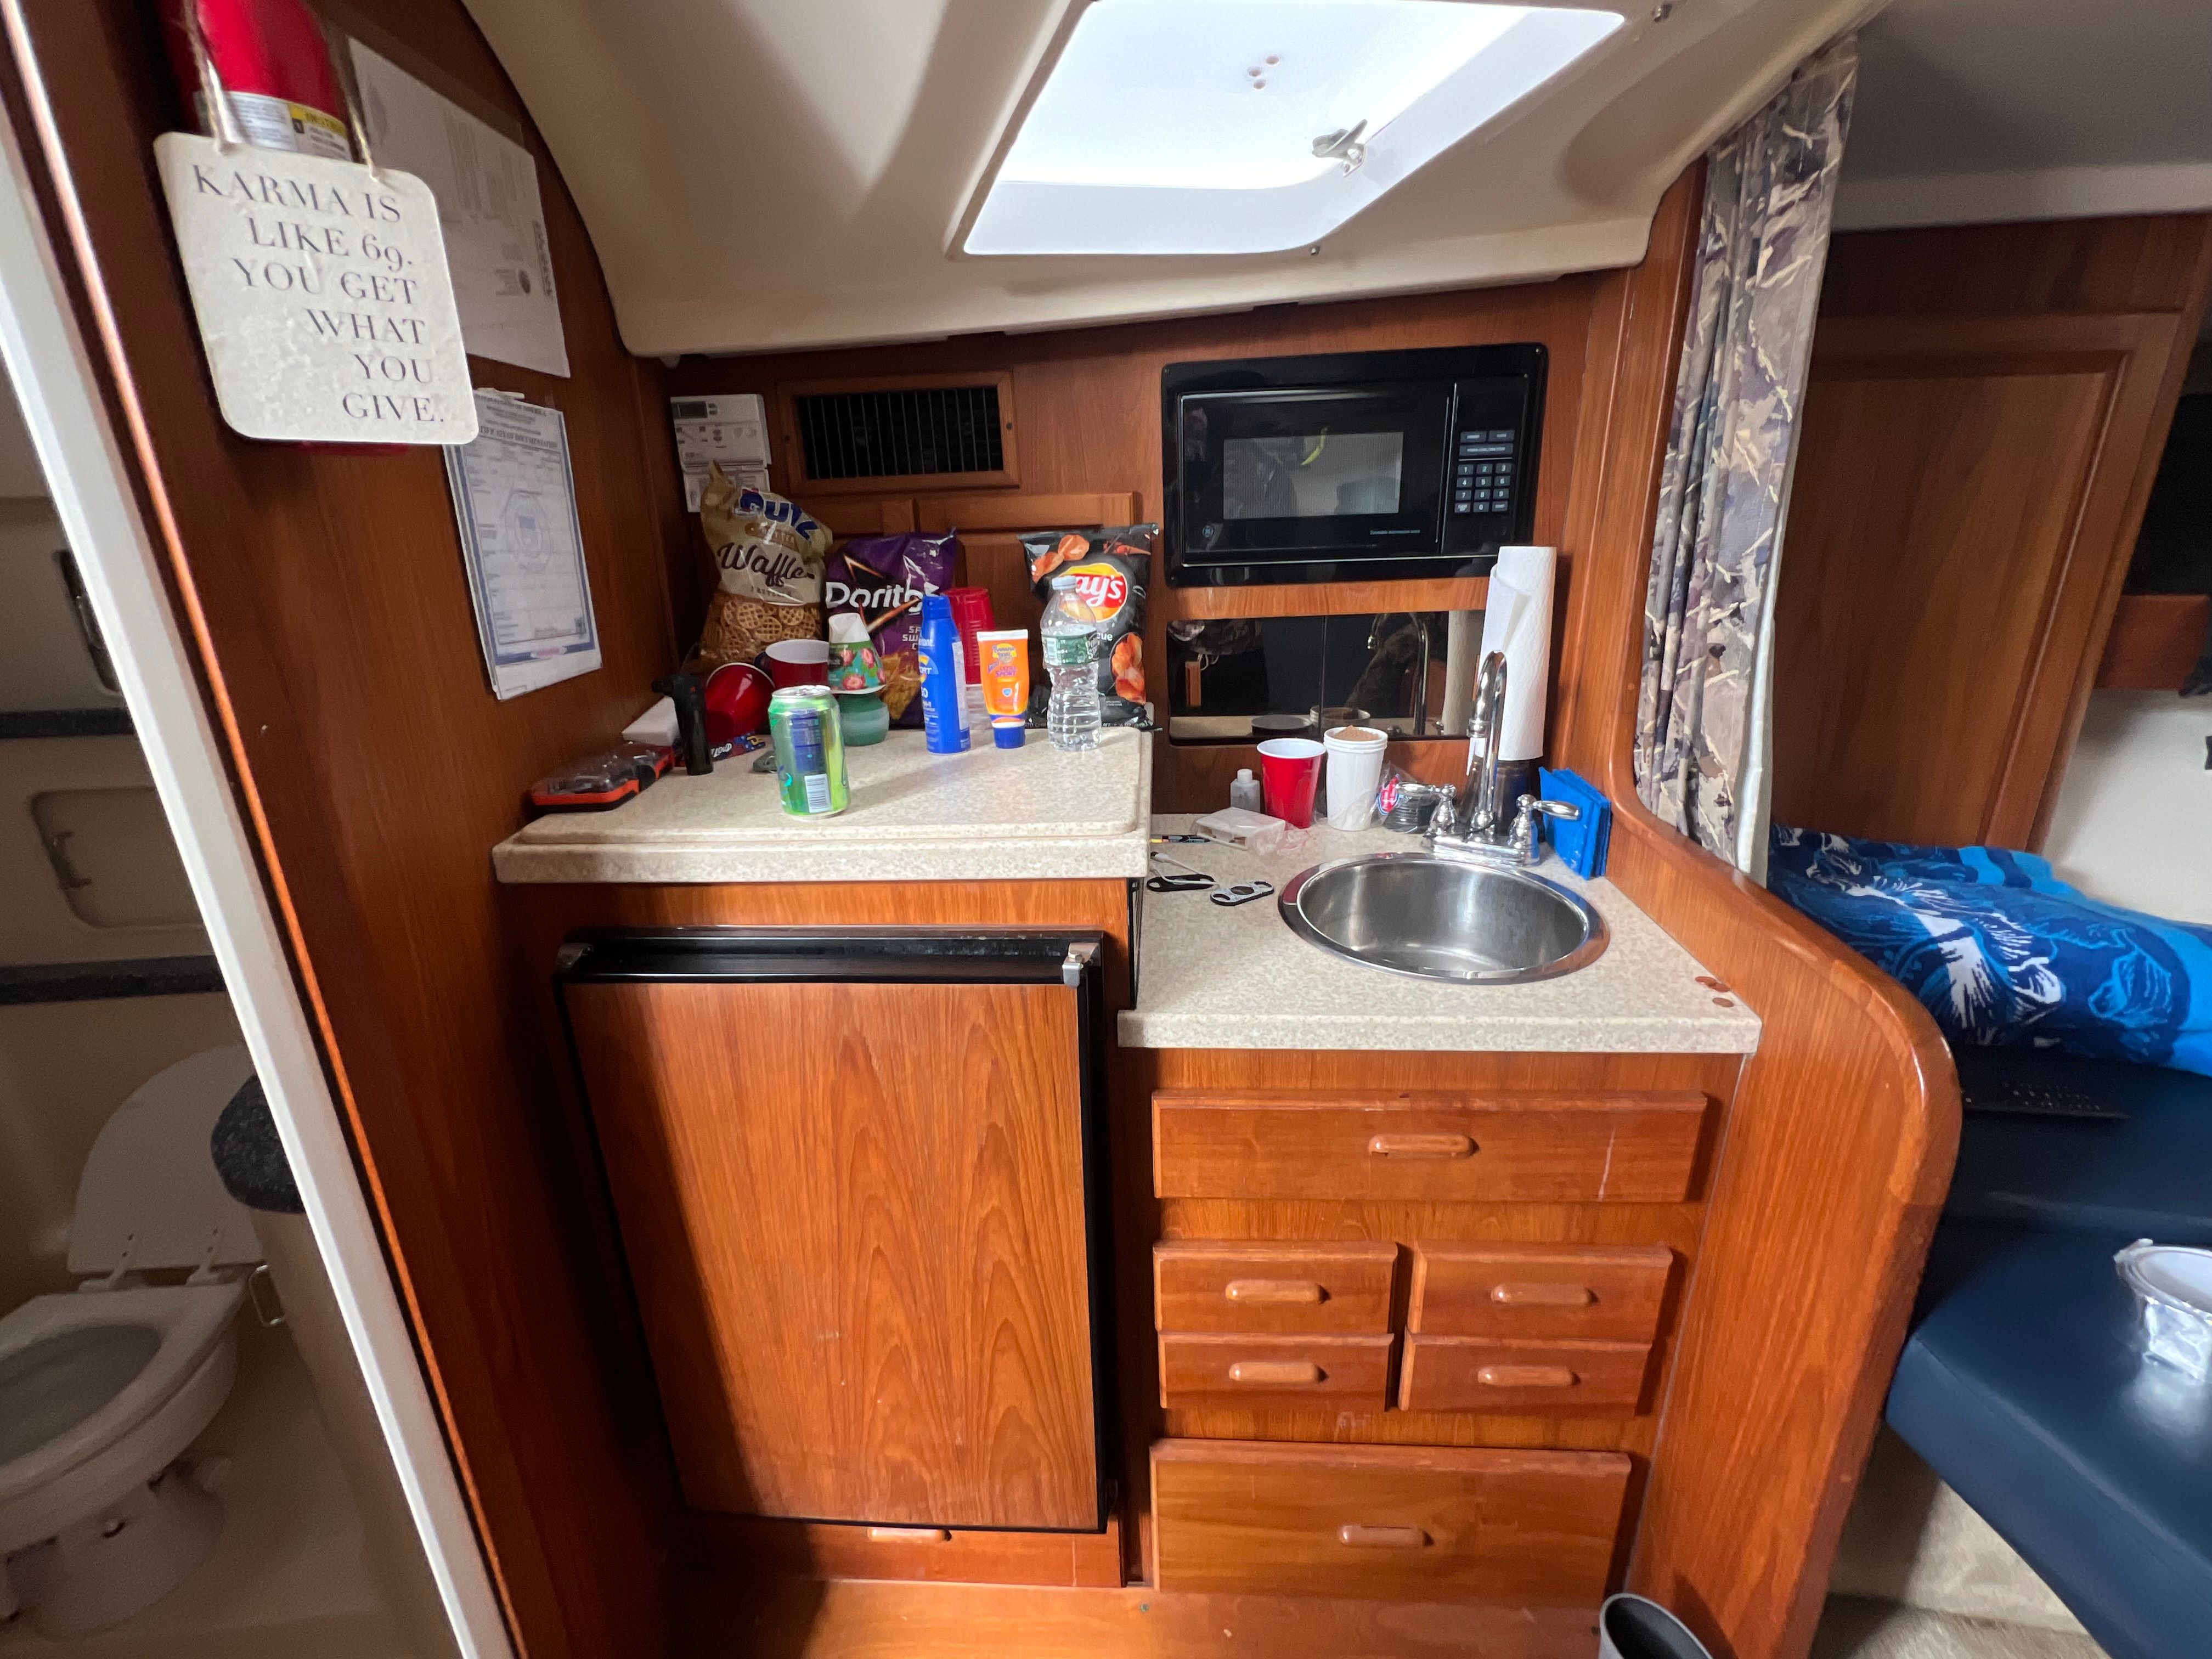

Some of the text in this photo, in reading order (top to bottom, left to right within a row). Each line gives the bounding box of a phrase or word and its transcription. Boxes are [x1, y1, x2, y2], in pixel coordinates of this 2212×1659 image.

[193, 165, 401, 223] KARMA IS
[247, 217, 413, 272] LIKE 69.
[231, 257, 417, 305] YOU GET
[304, 308, 425, 345] WHAT
[350, 352, 437, 384] YOU
[342, 393, 444, 422] GIVE.
[1075, 574, 1124, 607] ay's
[918, 666, 933, 675] ORT
